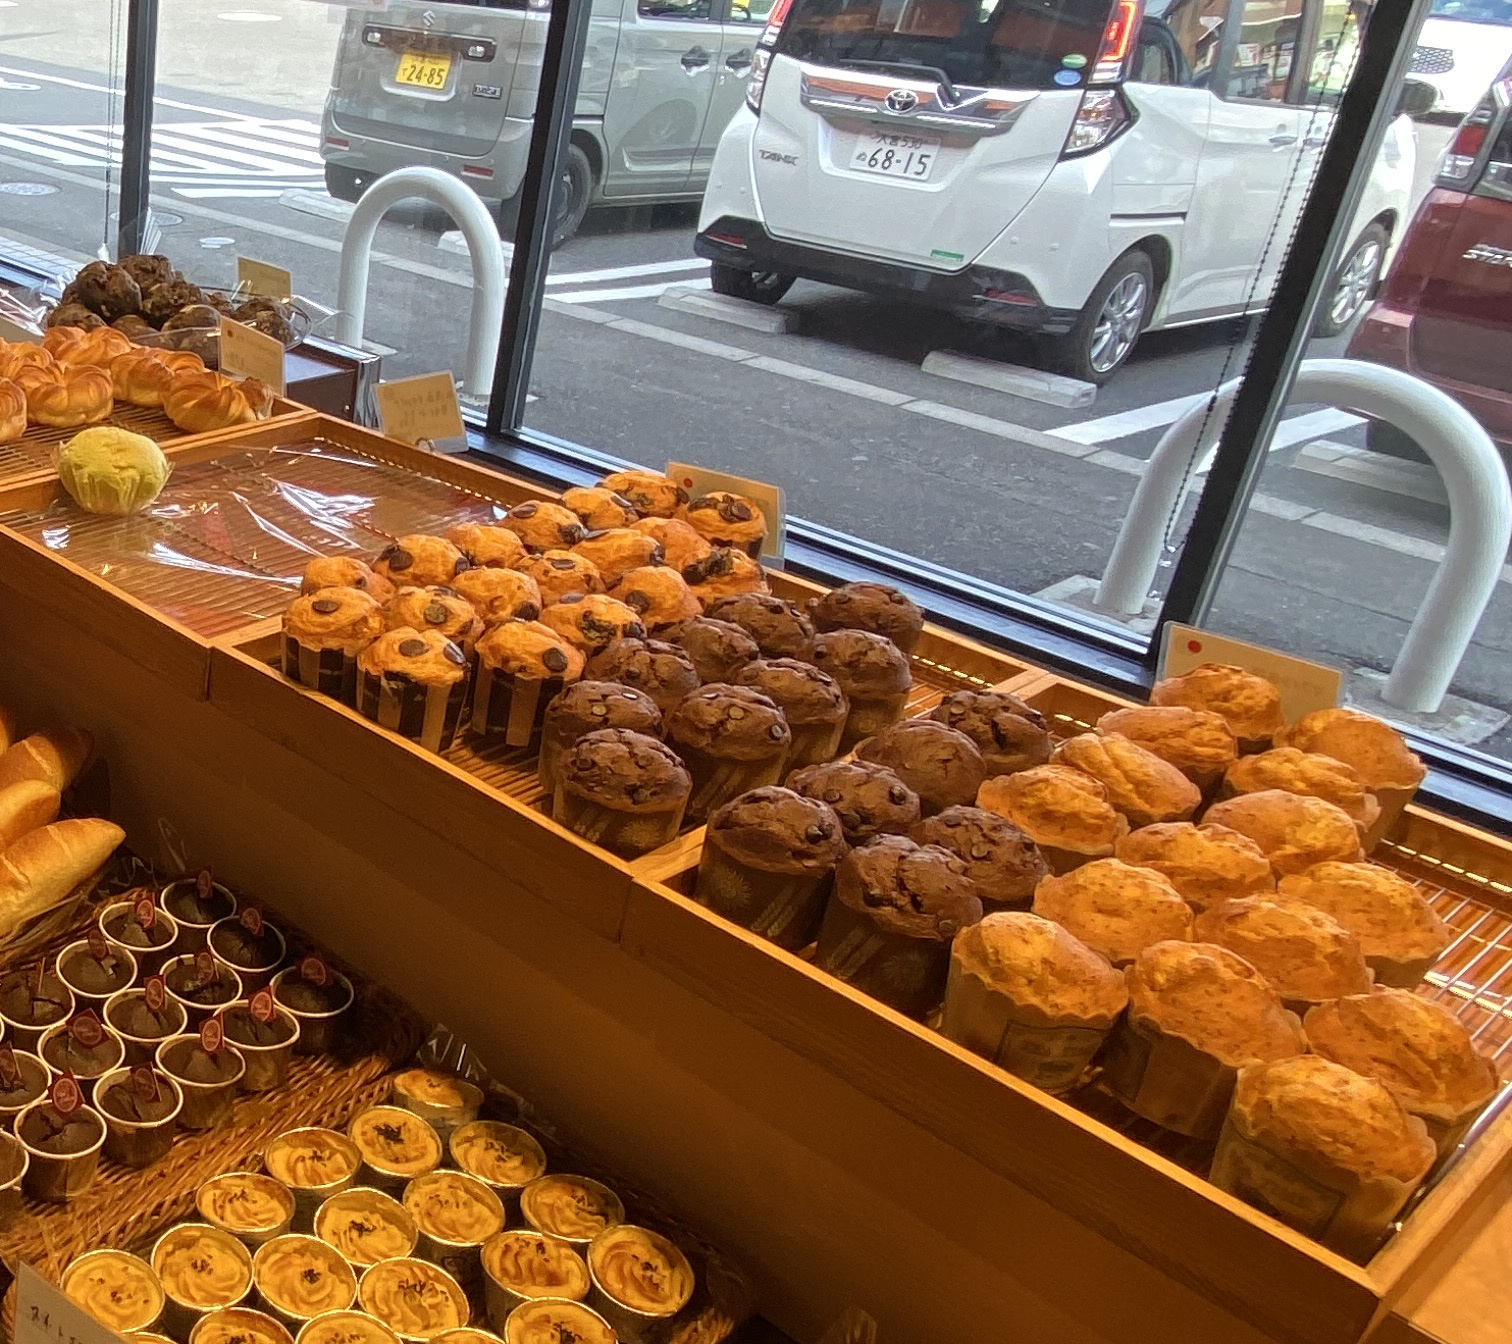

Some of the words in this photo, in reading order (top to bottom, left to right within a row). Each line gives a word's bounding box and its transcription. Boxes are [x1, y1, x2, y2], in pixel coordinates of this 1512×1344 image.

[406, 64, 445, 86] 24-85
[758, 149, 799, 167] TANK
[867, 147, 931, 176] 68-15
